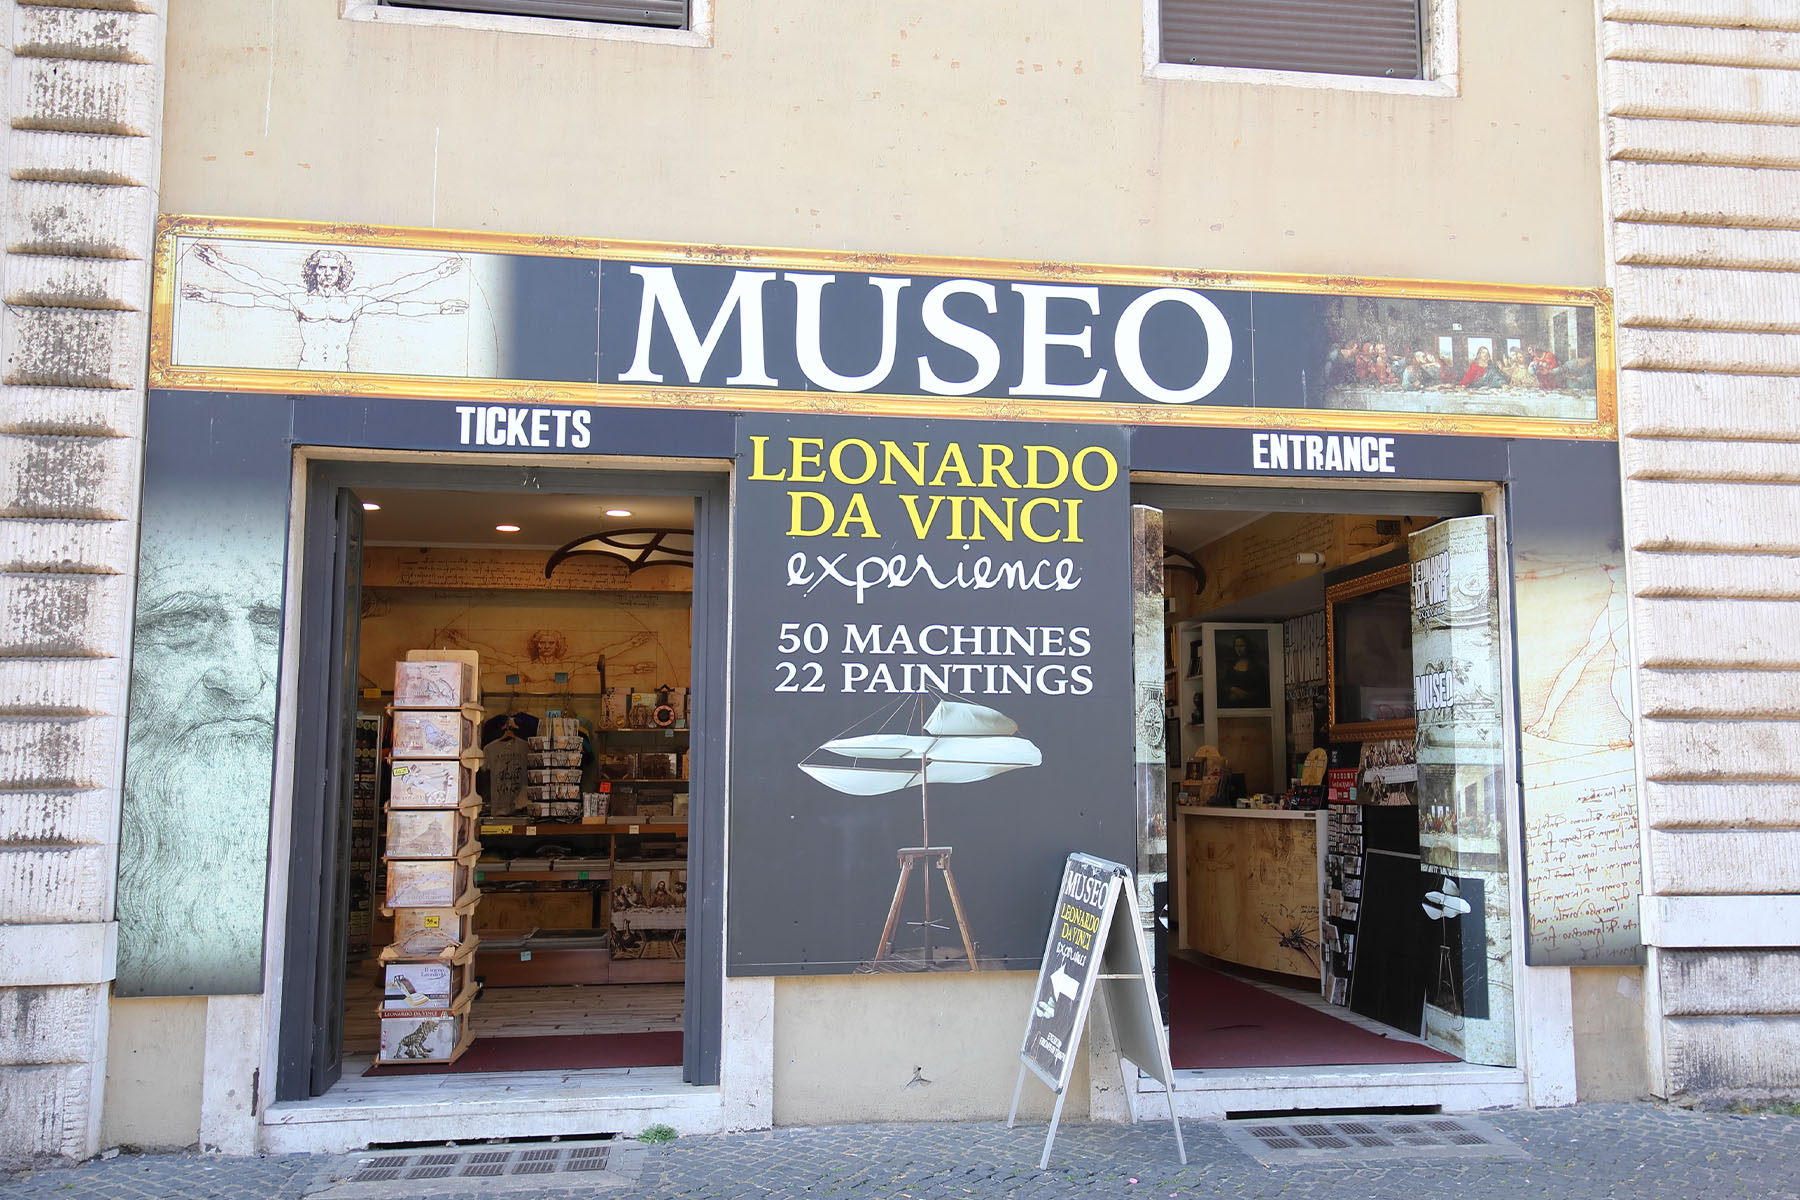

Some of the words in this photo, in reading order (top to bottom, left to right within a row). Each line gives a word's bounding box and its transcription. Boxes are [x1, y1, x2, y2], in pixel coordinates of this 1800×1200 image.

[617, 264, 1234, 404] MUSEO
[455, 405, 592, 449] TICKETS
[747, 435, 1119, 492] LEONARDO
[1252, 433, 1396, 473] ENTRANCE
[785, 490, 881, 539] DA
[898, 493, 1085, 544] VINCI
[785, 543, 1084, 604] experience
[777, 622, 829, 655] 50
[841, 623, 1092, 657] MACHINES
[774, 661, 826, 693] 22
[840, 661, 1094, 696] PAINTINGS
[1415, 669, 1455, 712] MUSEO
[1064, 870, 1109, 910] MUSEO
[1060, 902, 1100, 934] LEONARDO
[1061, 922, 1073, 942] DA
[1072, 926, 1093, 951] VINCI
